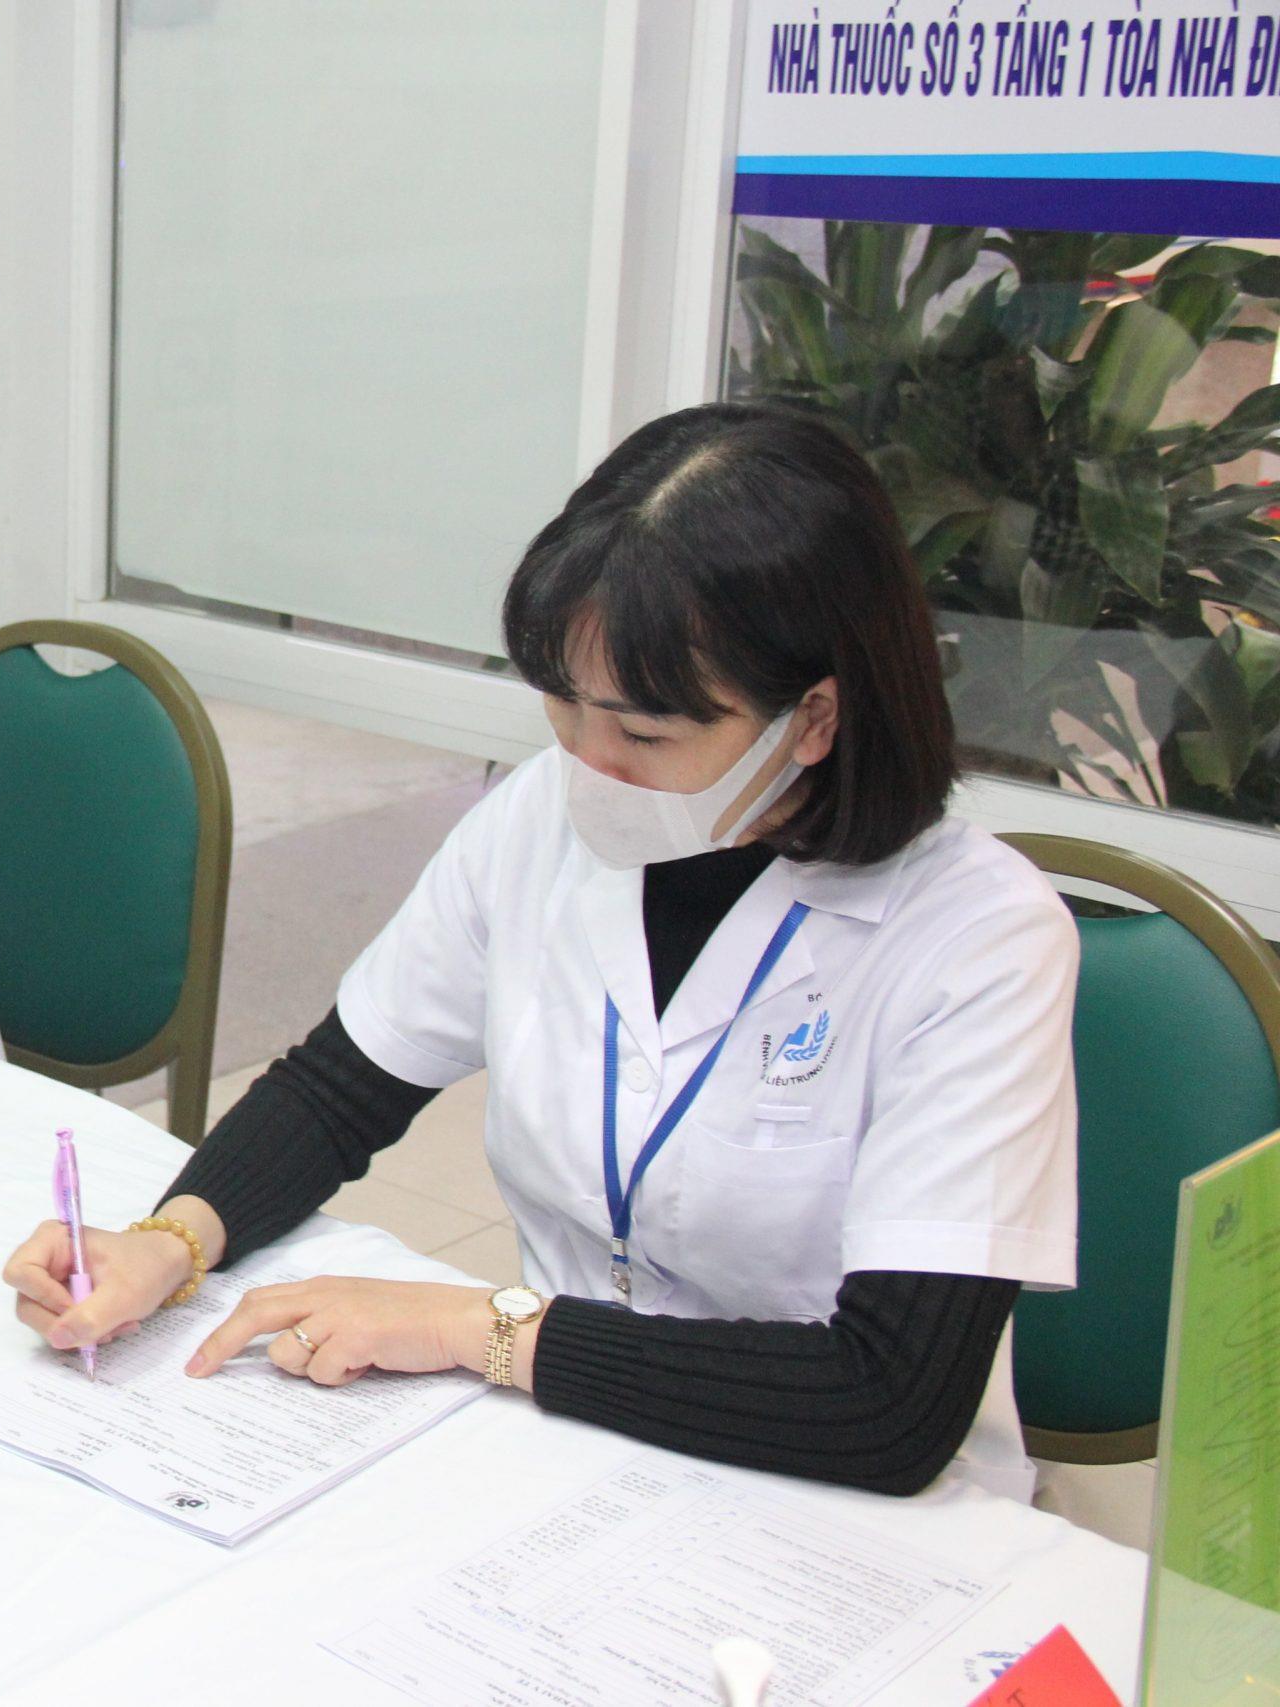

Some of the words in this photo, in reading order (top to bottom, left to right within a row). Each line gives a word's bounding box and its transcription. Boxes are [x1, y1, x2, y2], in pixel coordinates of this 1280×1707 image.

[768, 7, 820, 94] NHÀ
[830, 0, 915, 95] THUỐC
[920, 0, 963, 97] SỐ
[965, 22, 985, 97] 3
[1078, 21, 1094, 97] 1
[1104, 0, 1161, 98] TÒA
[1168, 0, 1239, 97] NHÀ
[1245, 15, 1280, 97] ĐI
